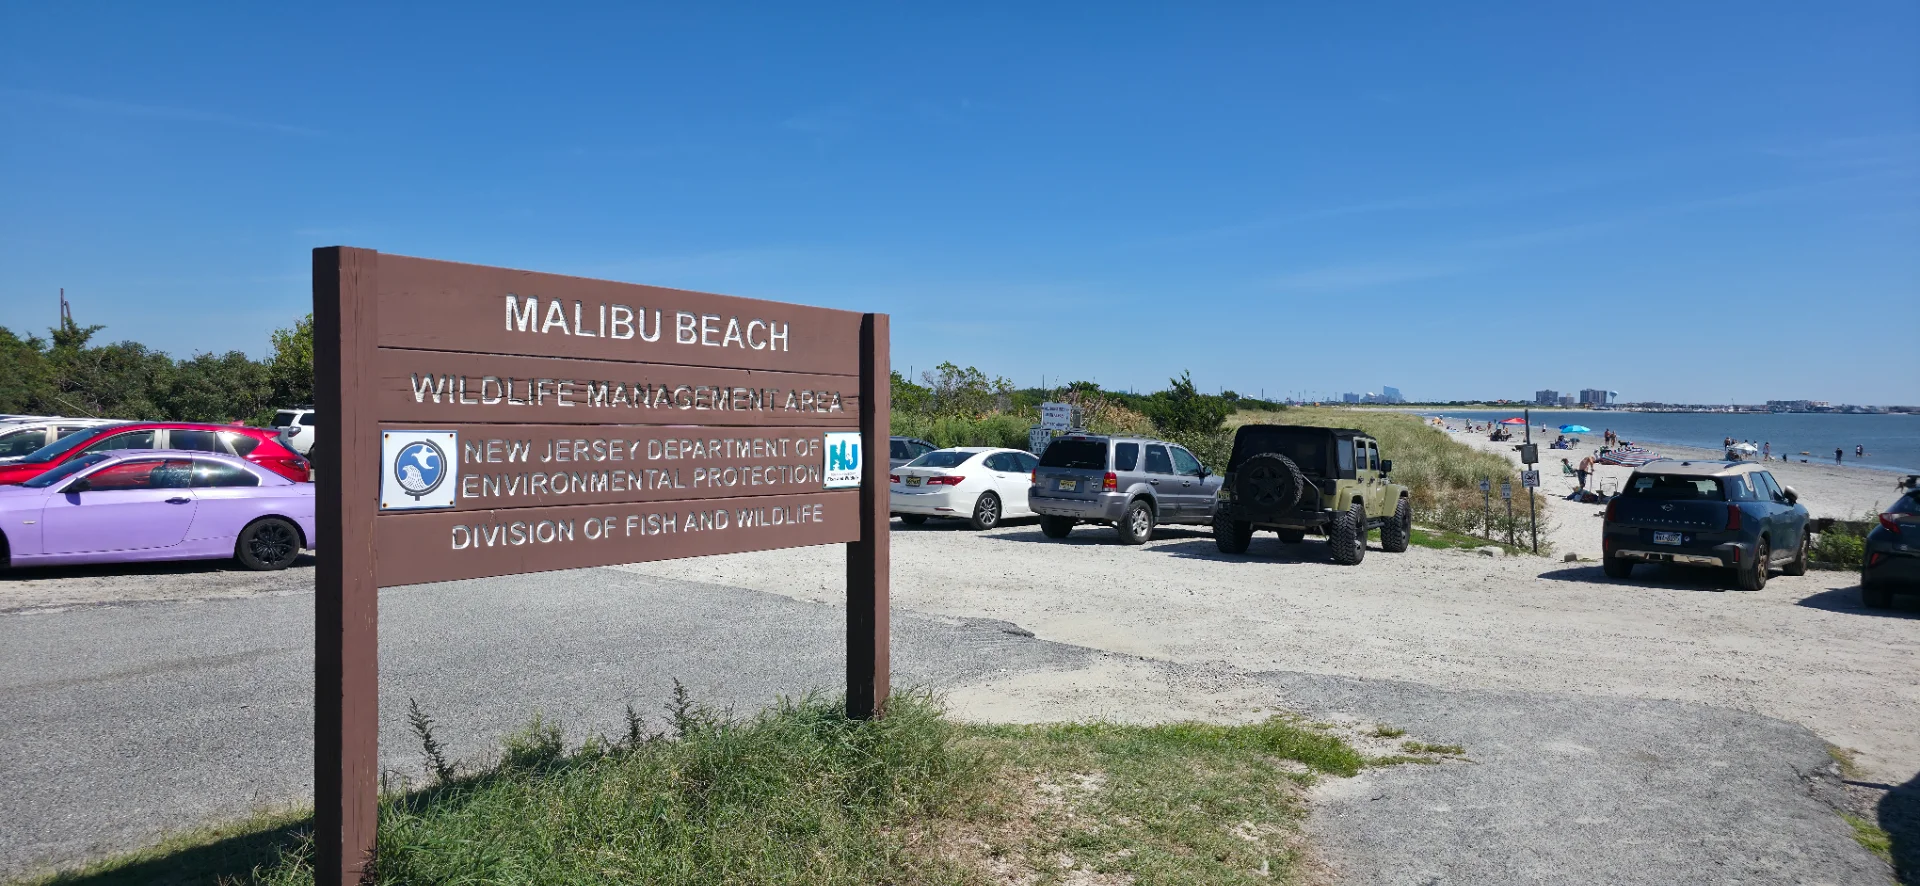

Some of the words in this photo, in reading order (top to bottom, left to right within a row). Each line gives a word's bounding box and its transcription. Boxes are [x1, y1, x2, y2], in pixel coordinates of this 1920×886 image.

[505, 293, 663, 343] MALIBU
[676, 311, 790, 352] BEACH
[411, 372, 575, 406] WILDLIFE
[587, 380, 780, 411] MANAGEMENT
[785, 389, 844, 413] AREA
[464, 439, 532, 463] NEW
[539, 439, 641, 462] JERSEY
[647, 438, 790, 460] DEPARTMENT
[795, 438, 820, 457] OF
[829, 439, 858, 471] NJ
[462, 468, 687, 498] ENVIRONMENTAL
[693, 464, 821, 488] PROTECTION
[452, 519, 575, 550] DIVISION
[583, 516, 618, 540] OF
[626, 511, 678, 537] FISH
[683, 508, 731, 533] AND
[735, 503, 824, 528] WILDLIFE
